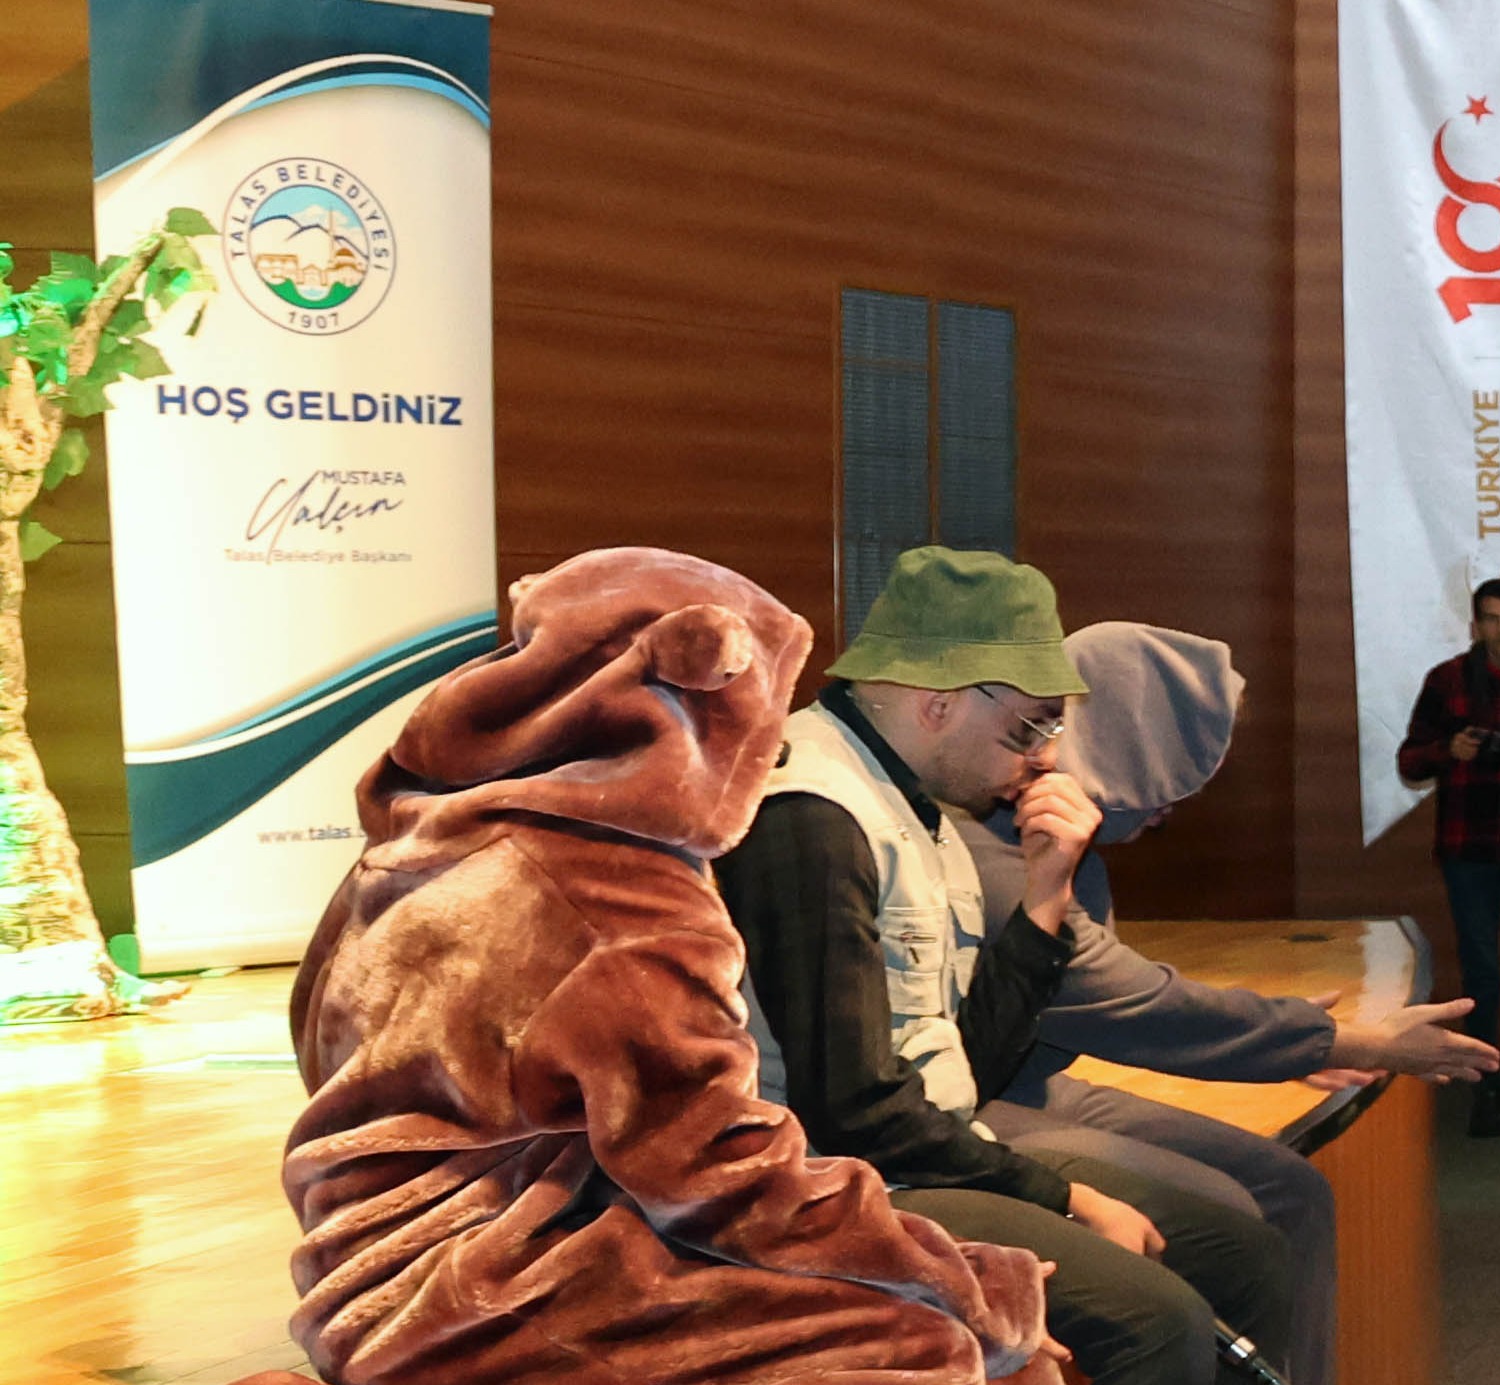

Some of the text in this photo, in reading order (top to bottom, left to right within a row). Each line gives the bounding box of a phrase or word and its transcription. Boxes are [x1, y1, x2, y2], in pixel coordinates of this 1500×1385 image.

[230, 179, 267, 262] TALAS
[287, 311, 340, 330] 1907
[156, 384, 250, 424] HOŞ
[322, 469, 407, 485] MUSTAFA
